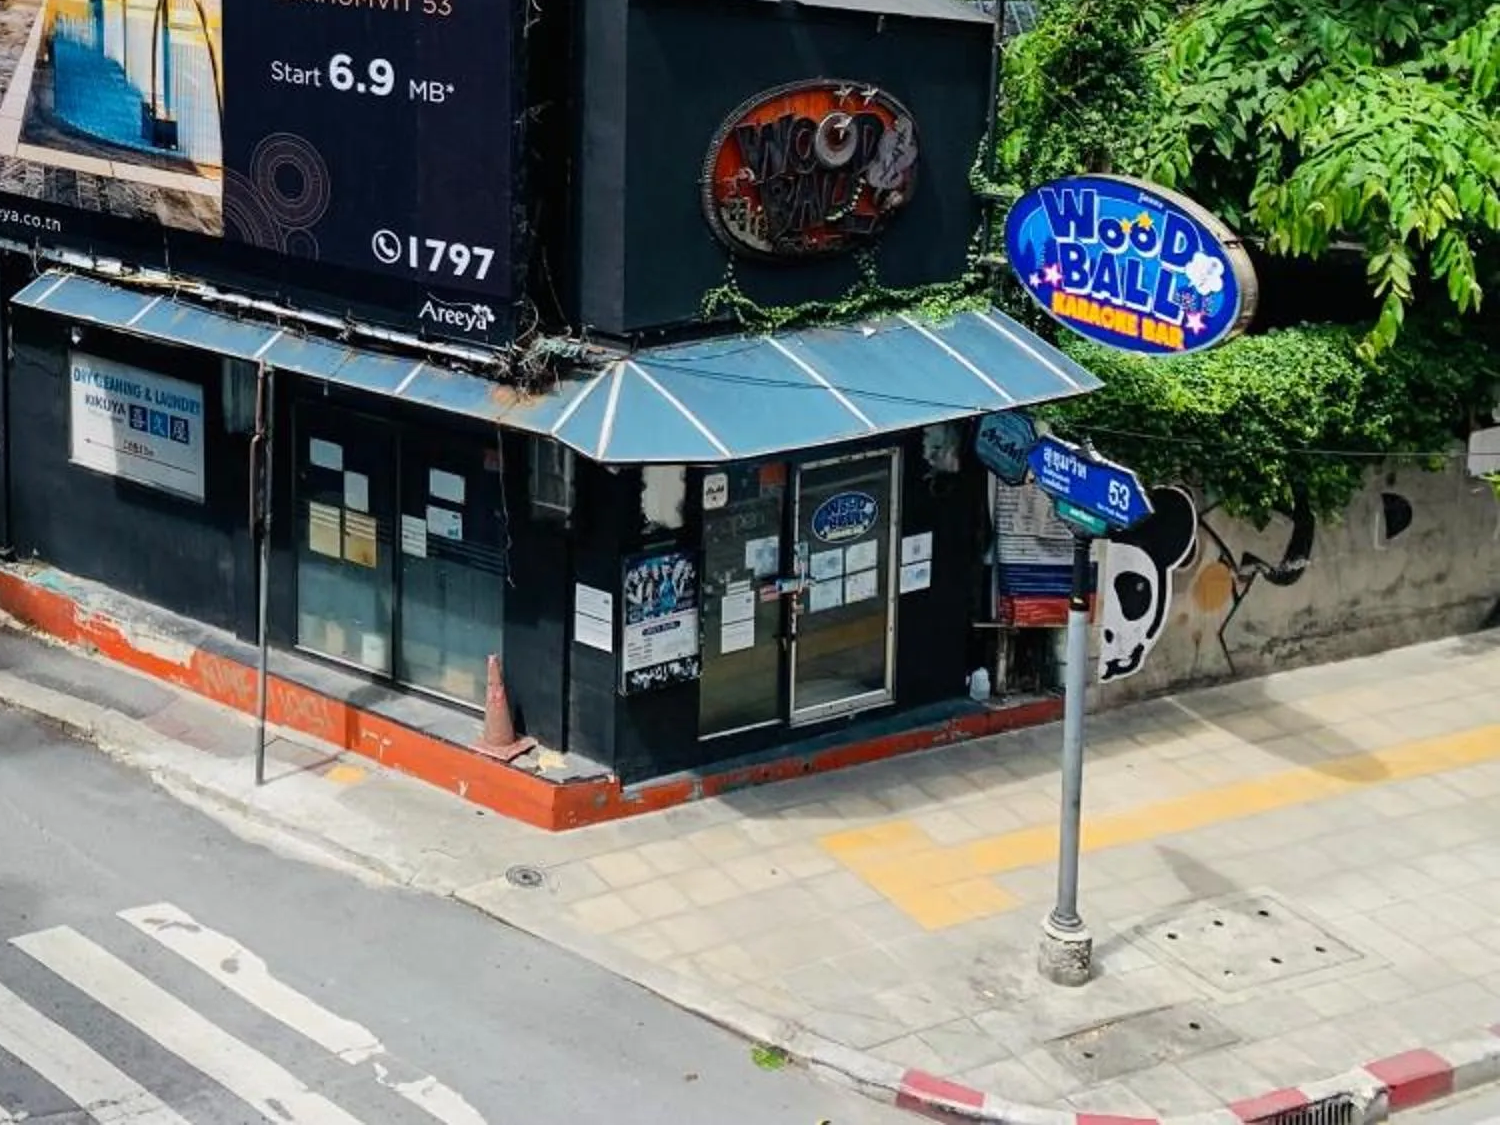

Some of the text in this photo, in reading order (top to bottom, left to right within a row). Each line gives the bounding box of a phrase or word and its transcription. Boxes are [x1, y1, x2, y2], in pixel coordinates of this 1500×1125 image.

[271, 61, 321, 87] Start
[328, 53, 395, 96] 6.9
[408, 235, 495, 281] 1797
[1056, 240, 1184, 326] BALL
[418, 300, 489, 332] Areeya
[1052, 291, 1185, 350] KARAOKE BAR
[1108, 478, 1130, 511] 53
